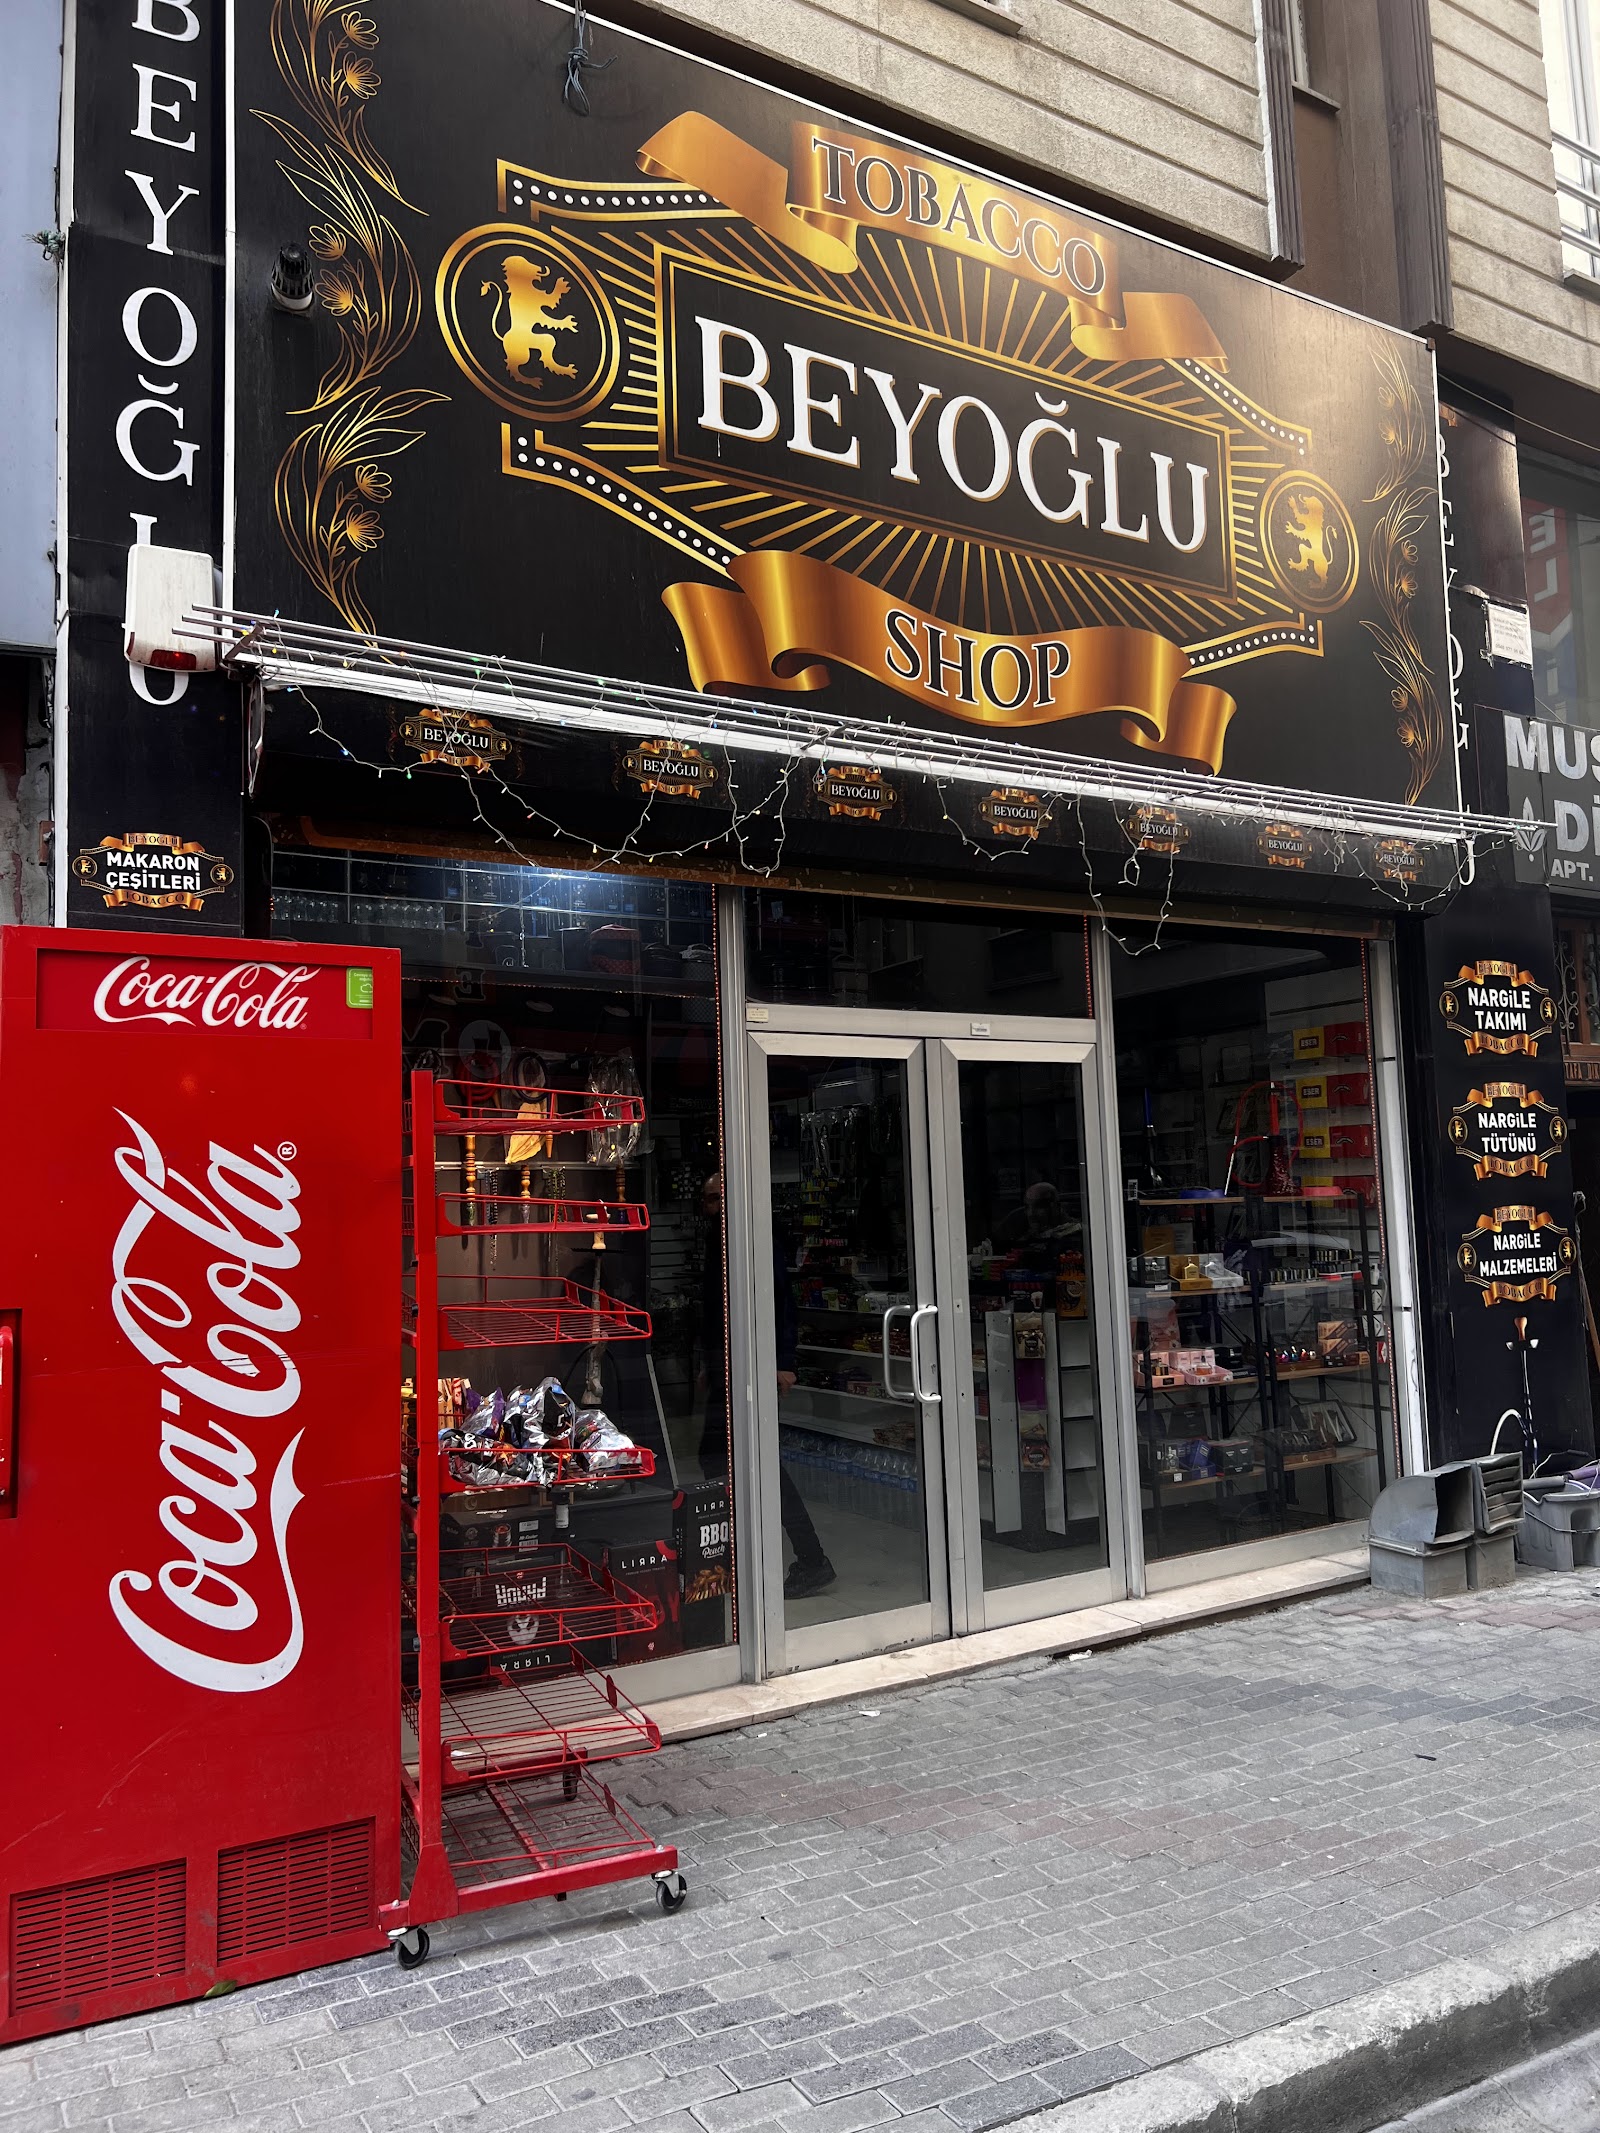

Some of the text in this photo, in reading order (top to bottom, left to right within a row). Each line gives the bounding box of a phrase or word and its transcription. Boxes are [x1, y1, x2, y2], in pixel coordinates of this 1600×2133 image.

[810, 137, 1107, 297] TOBACCO
[694, 315, 1210, 554] BEYOĞLU
[884, 608, 1071, 711] SHOP
[1503, 714, 1600, 783] MU
[643, 759, 700, 778] BEYOĞLU
[831, 784, 880, 801] BEYOĞLU
[994, 805, 1038, 820] BEYOĞLU
[106, 851, 200, 872] MAKARON
[1550, 858, 1594, 882] APT.
[106, 869, 201, 891] ÇEŞİTLERİ
[125, 891, 185, 906] TOBACCO
[93, 955, 322, 1030] Coca-Cola
[1474, 1010, 1527, 1031] TAKIMI
[1481, 1132, 1537, 1153] TÜTÜNÜ
[1479, 1251, 1558, 1278] MALZEMELERİ
[108, 1106, 306, 1692] Coca-Cola
[699, 1520, 730, 1548] BBQ
